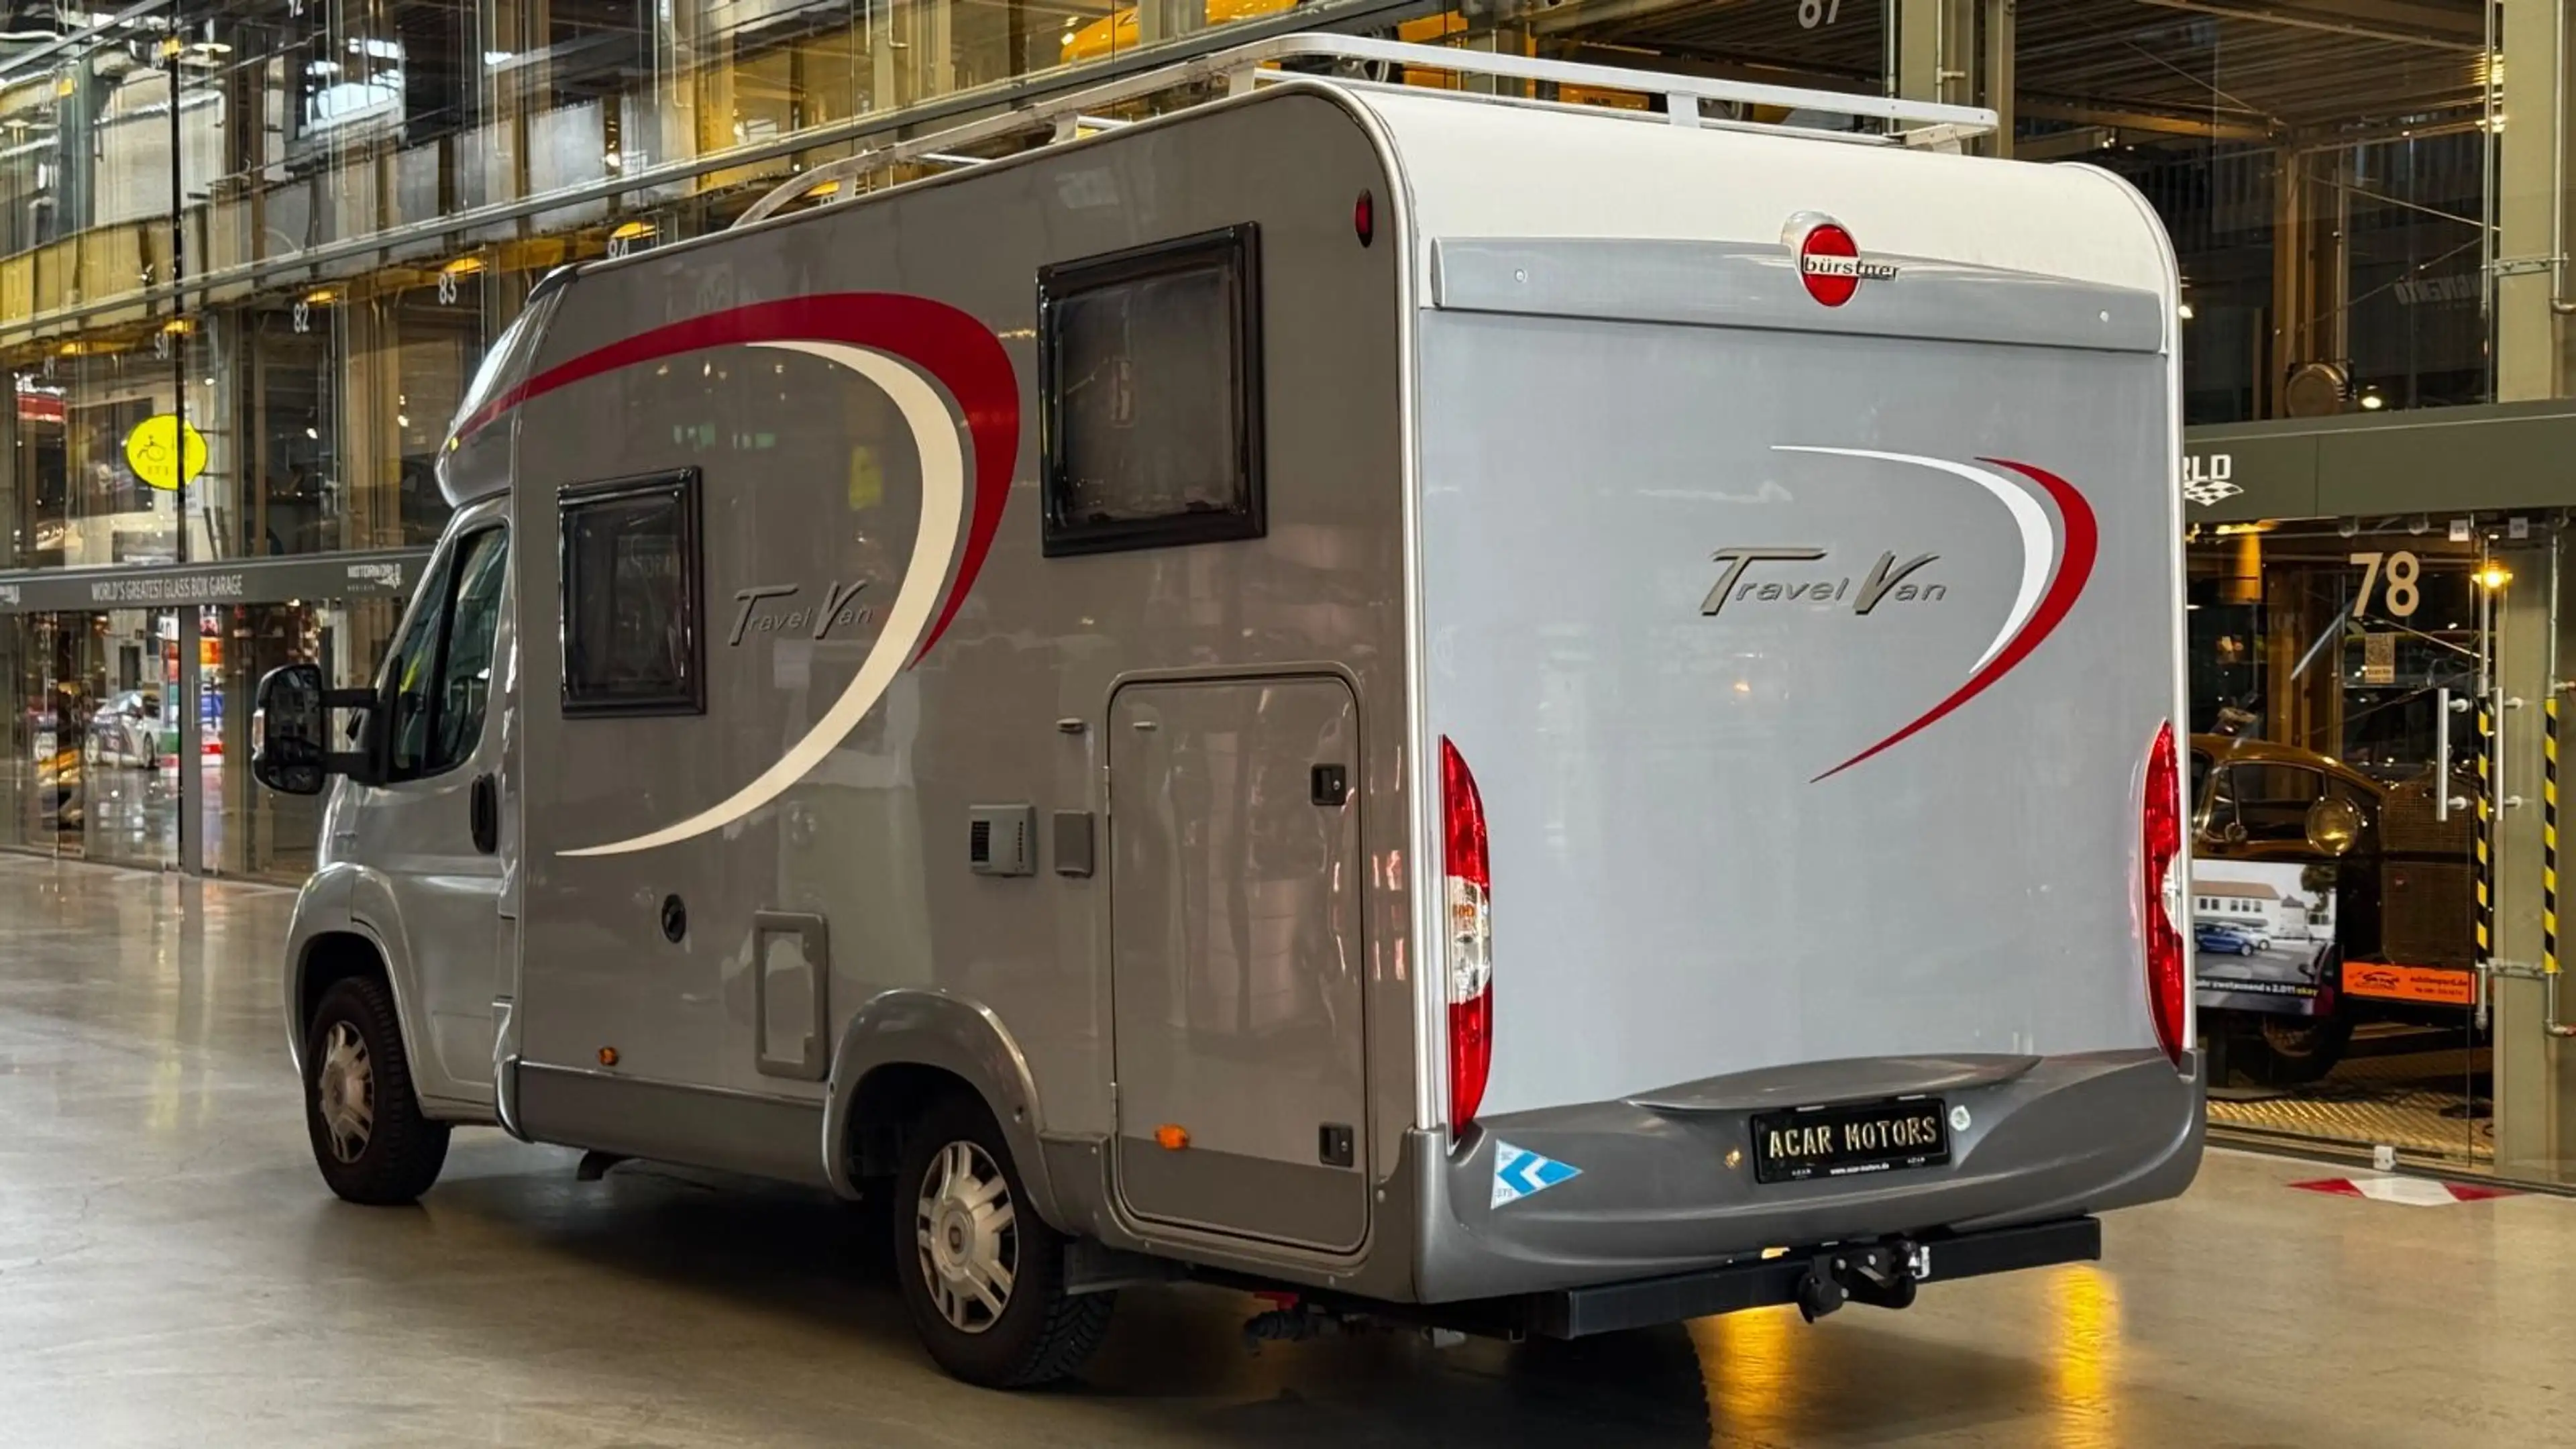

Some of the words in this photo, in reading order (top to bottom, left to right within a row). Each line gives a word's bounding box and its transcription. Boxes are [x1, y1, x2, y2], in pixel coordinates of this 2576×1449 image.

[1805, 256, 1898, 280] bürstner
[439, 272, 457, 305] 83
[293, 302, 309, 333] 82
[126, 579, 163, 600] GREATEST
[164, 577, 190, 598] GLASS
[209, 574, 243, 597] GARAGE
[1699, 547, 1849, 616] Travel
[1852, 549, 1947, 615] Van
[2350, 551, 2419, 617] 78
[729, 582, 812, 646] Travel
[814, 579, 873, 640] Van
[1769, 1124, 1833, 1159] ACAR
[1844, 1116, 1937, 1151] MOTORS
